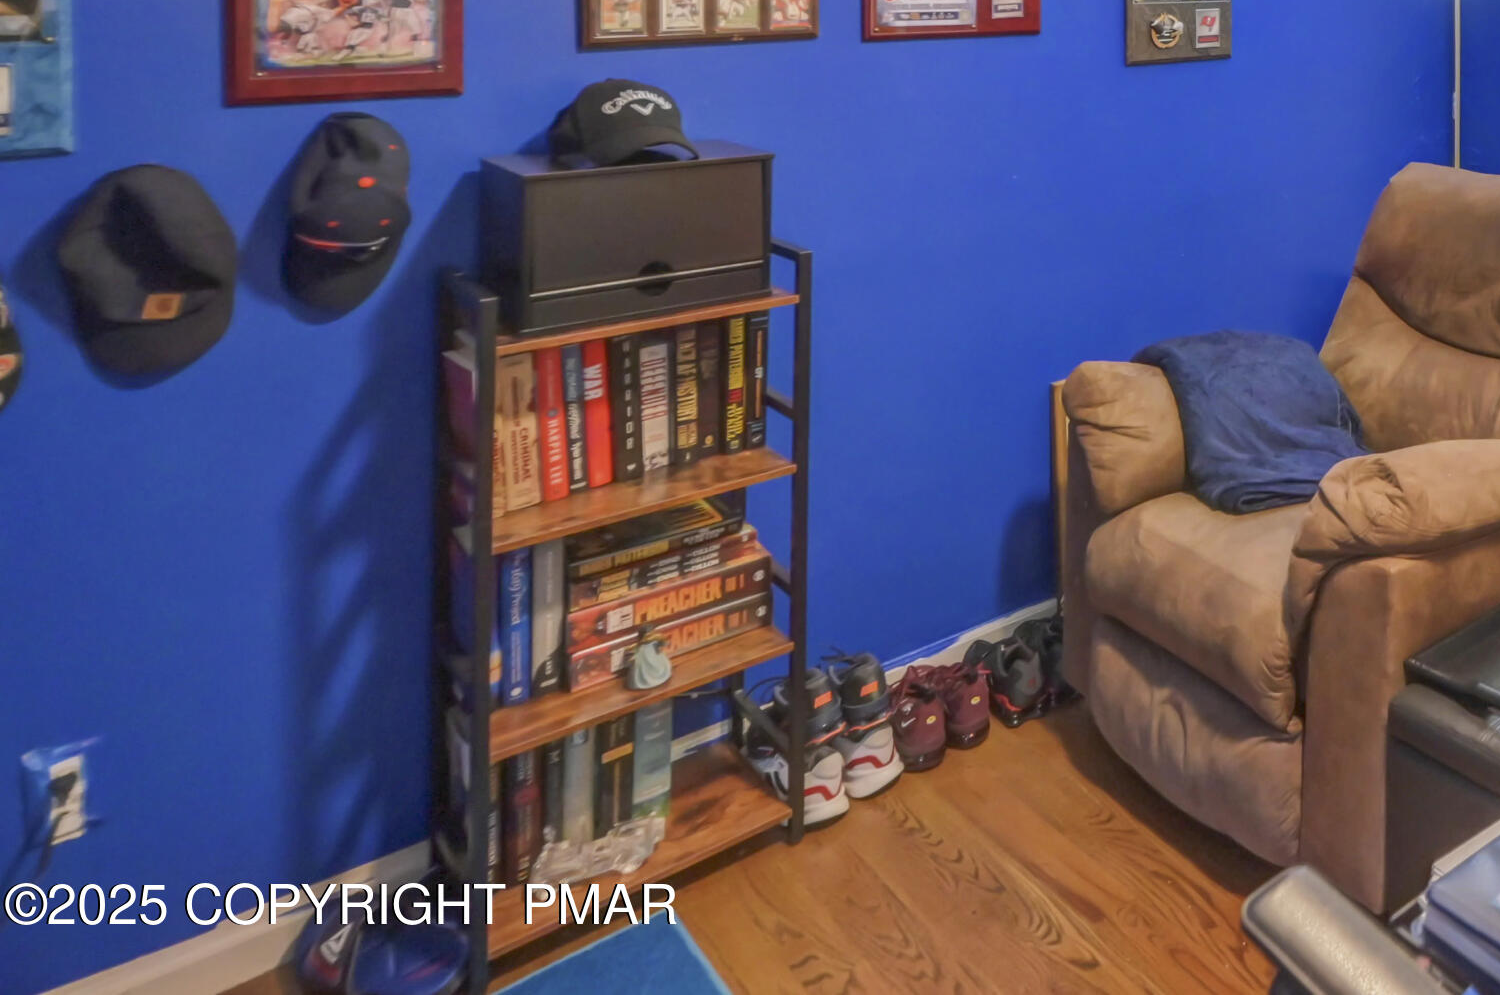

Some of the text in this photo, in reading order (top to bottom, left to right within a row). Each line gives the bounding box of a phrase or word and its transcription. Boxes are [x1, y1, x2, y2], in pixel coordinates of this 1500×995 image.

[583, 363, 605, 402] WAR
[640, 356, 669, 422] DEFENDER
[519, 427, 532, 482] CRIMINAL
[547, 419, 562, 463] HARPER
[549, 465, 563, 485] LEE
[634, 576, 723, 625] PREACHER
